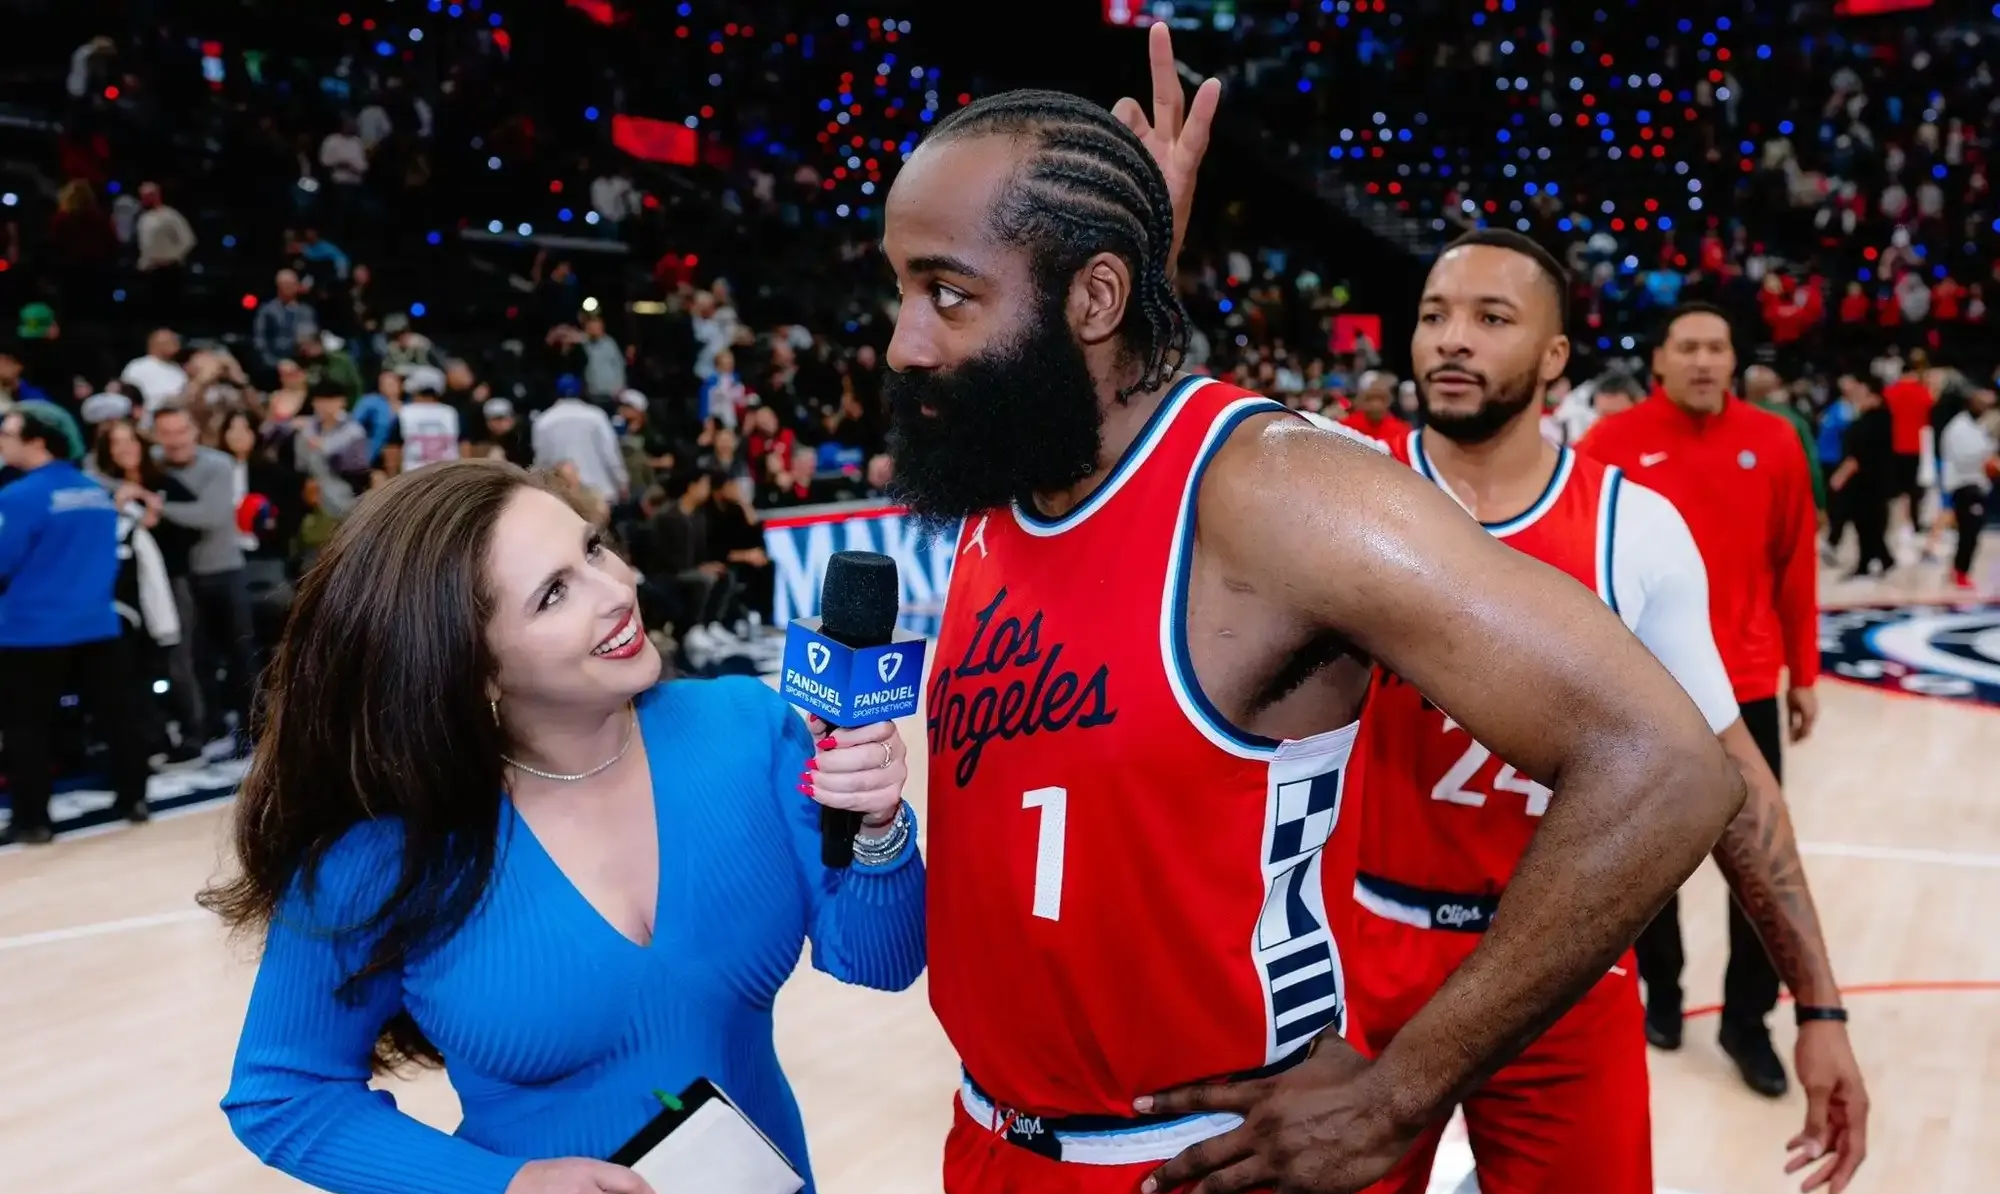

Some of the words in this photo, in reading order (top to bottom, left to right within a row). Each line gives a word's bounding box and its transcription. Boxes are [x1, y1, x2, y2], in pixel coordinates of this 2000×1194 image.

[955, 586, 1044, 680] Los
[785, 684, 810, 702] SPORTS
[809, 696, 841, 717] NETWORK
[786, 668, 842, 707] FANDUEL
[853, 685, 915, 708] FANDUEL
[852, 706, 880, 719] SPORTS
[880, 700, 913, 713] NETWORK
[927, 643, 1118, 789] Angeles
[1022, 786, 1067, 921] 1
[1436, 903, 1482, 928] Clips
